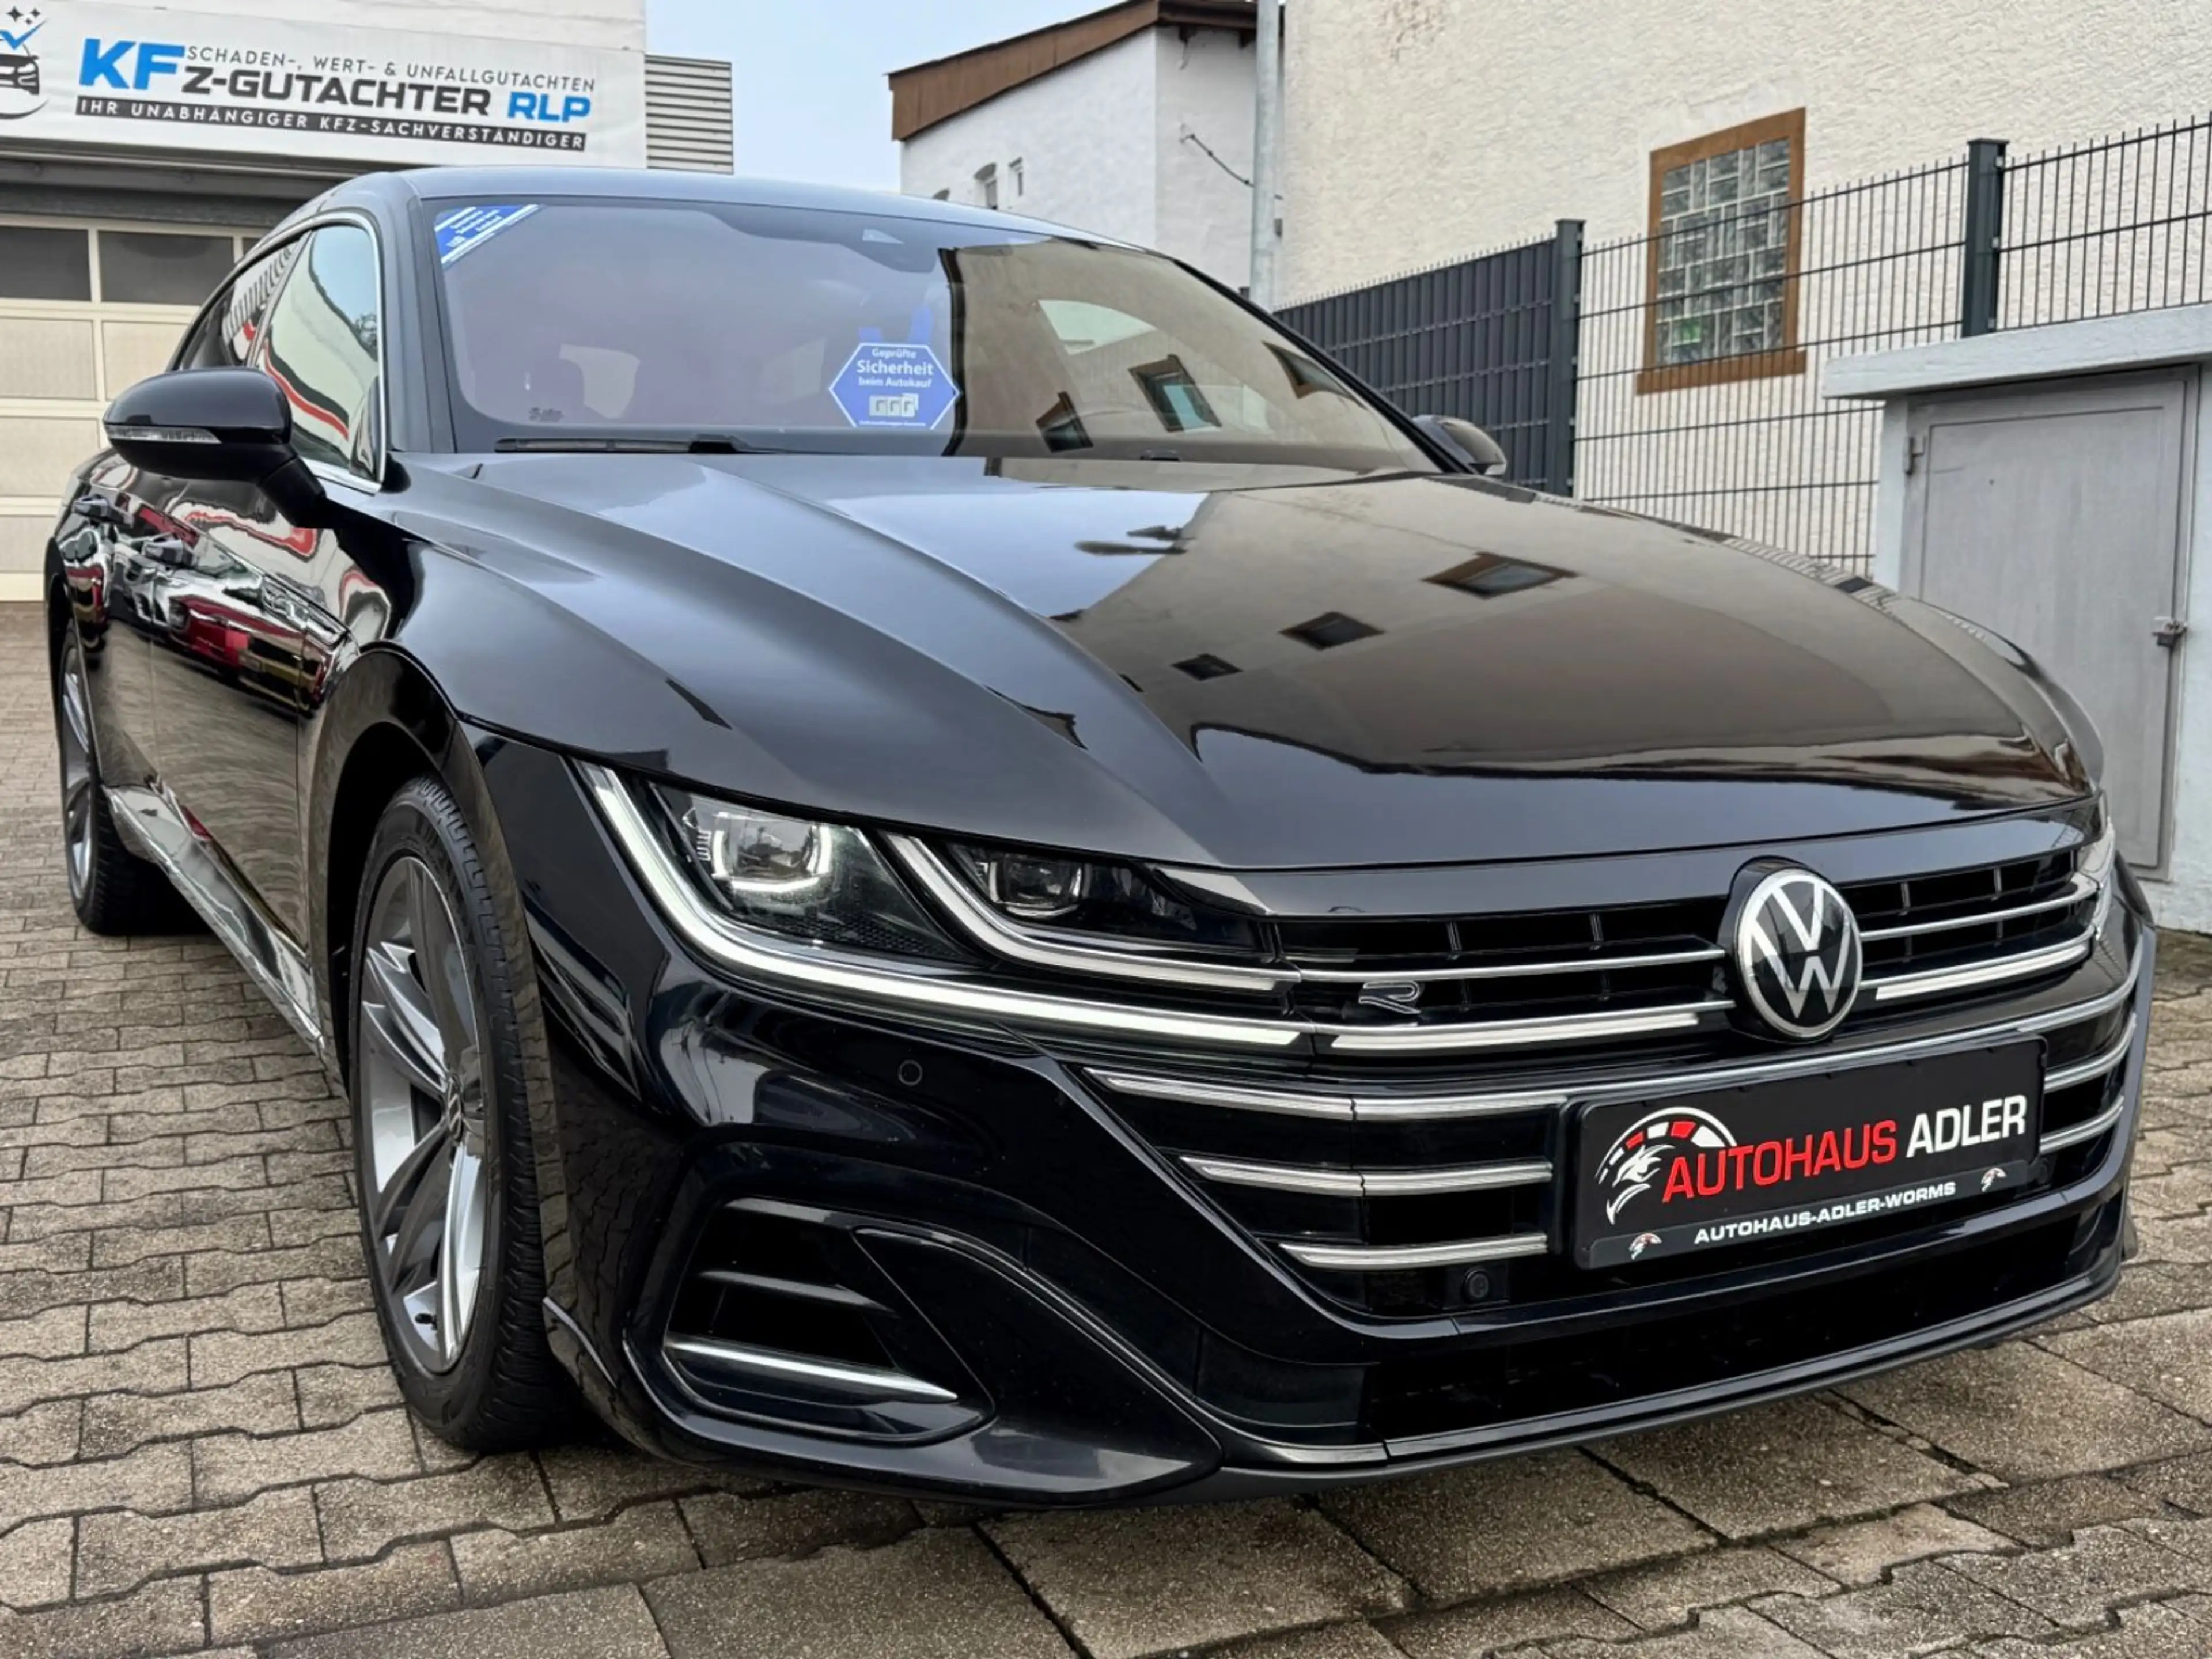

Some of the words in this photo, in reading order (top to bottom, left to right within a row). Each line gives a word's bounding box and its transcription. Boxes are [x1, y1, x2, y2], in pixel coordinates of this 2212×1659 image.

[313, 55, 376, 74] WERT-
[384, 62, 396, 76] &
[407, 63, 595, 92] UNFALLGUTACHTEN
[507, 90, 592, 123] RLP
[81, 100, 118, 114] IHR
[130, 102, 308, 128] UNABHÄNGIGER
[320, 116, 585, 149] KFZ-SACHVERSTÄNDIGER
[856, 359, 934, 376] Sicherheit
[872, 348, 916, 359] Geprüfte
[885, 377, 933, 388] Autokauf
[1743, 875, 1857, 1029] VW
[1358, 980, 1421, 1014] R
[1662, 1119, 1897, 1203] AUTOHAUS
[1906, 1094, 2027, 1158] ADLER
[1694, 1181, 1957, 1244] AUTOHAUS-ADLER-WORMS
